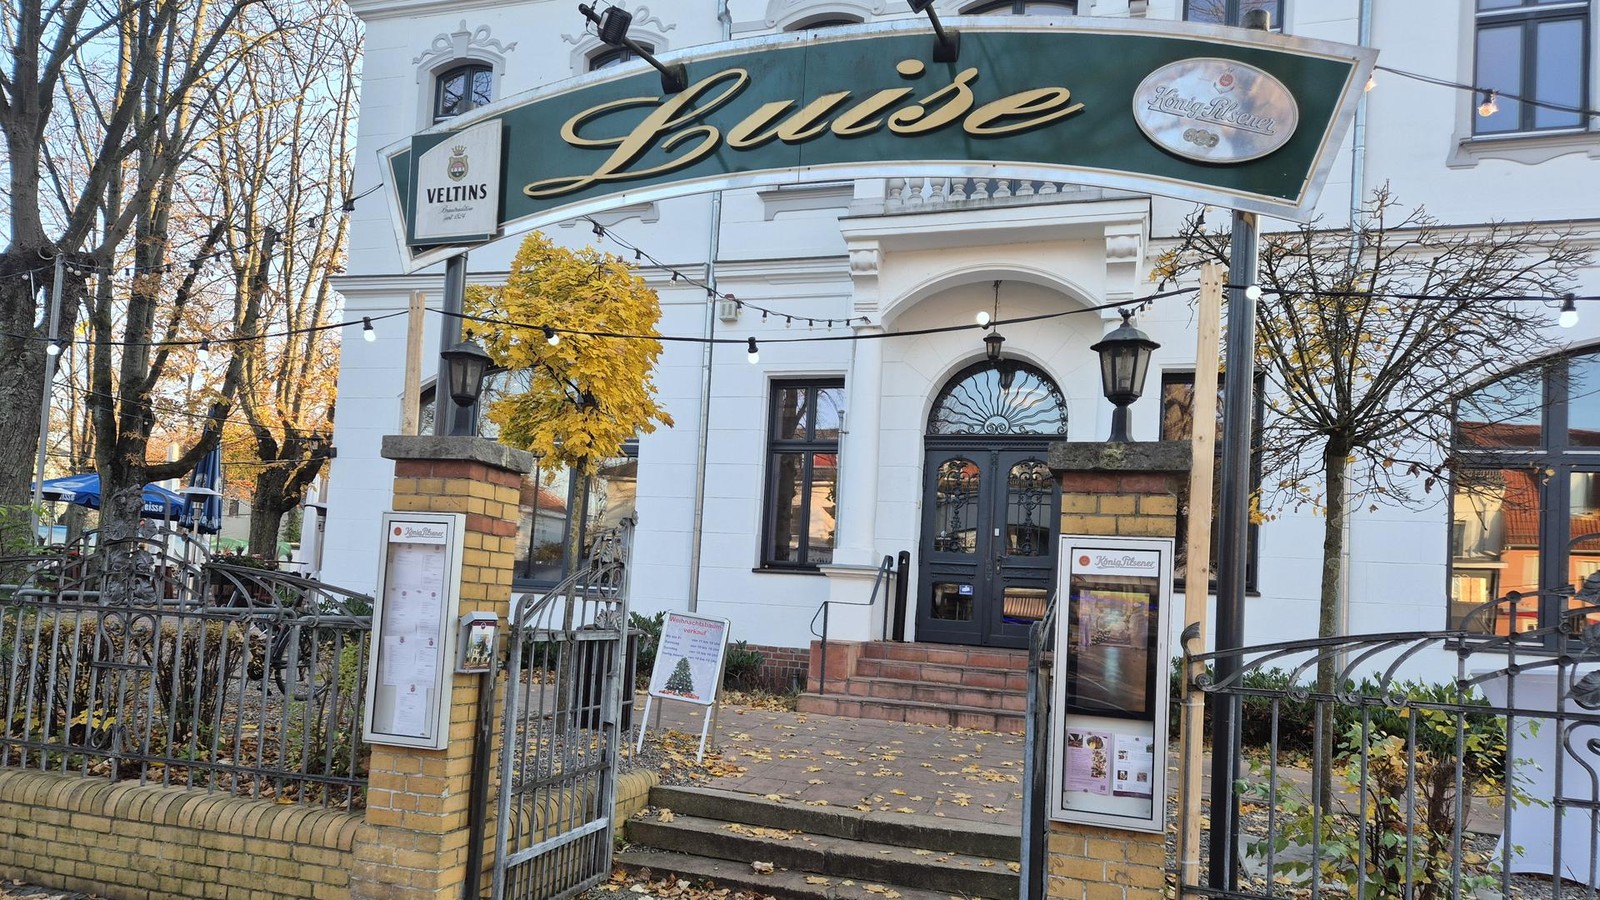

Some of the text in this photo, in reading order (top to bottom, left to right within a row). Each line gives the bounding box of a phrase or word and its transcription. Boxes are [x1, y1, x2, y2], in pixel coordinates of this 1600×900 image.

[522, 67, 1086, 197] Luise
[427, 183, 487, 204] VELTINS
[141, 501, 164, 513] eisse
[1095, 555, 1156, 569] König Pilsener
